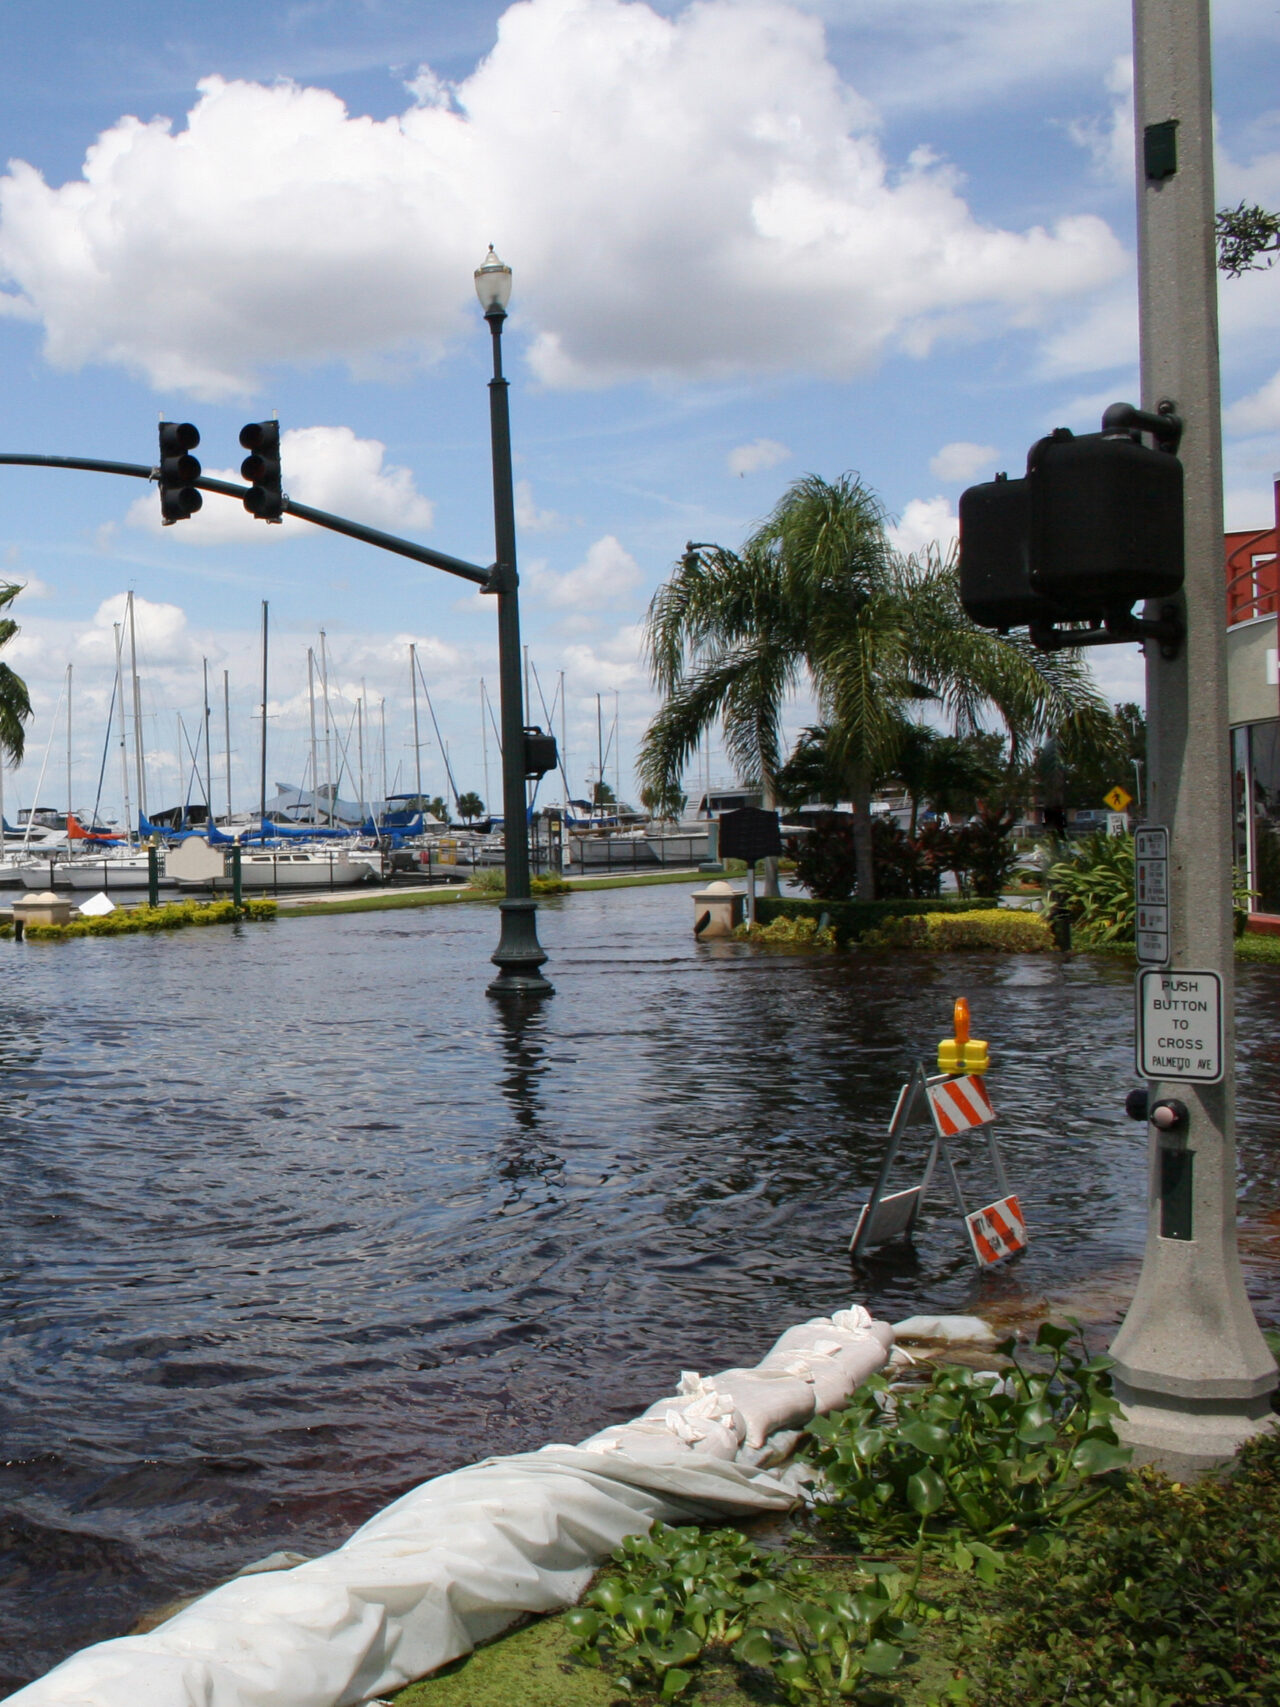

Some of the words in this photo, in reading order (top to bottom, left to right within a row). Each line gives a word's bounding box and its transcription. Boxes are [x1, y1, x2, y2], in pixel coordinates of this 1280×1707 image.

[1161, 981, 1199, 992] PUSH
[1153, 999, 1207, 1012] BUTTON
[1172, 1019, 1189, 1030] TO
[1157, 1037, 1204, 1050] CROSS
[1152, 1055, 1191, 1070] PALMETTO
[1197, 1058, 1211, 1070] AVE
